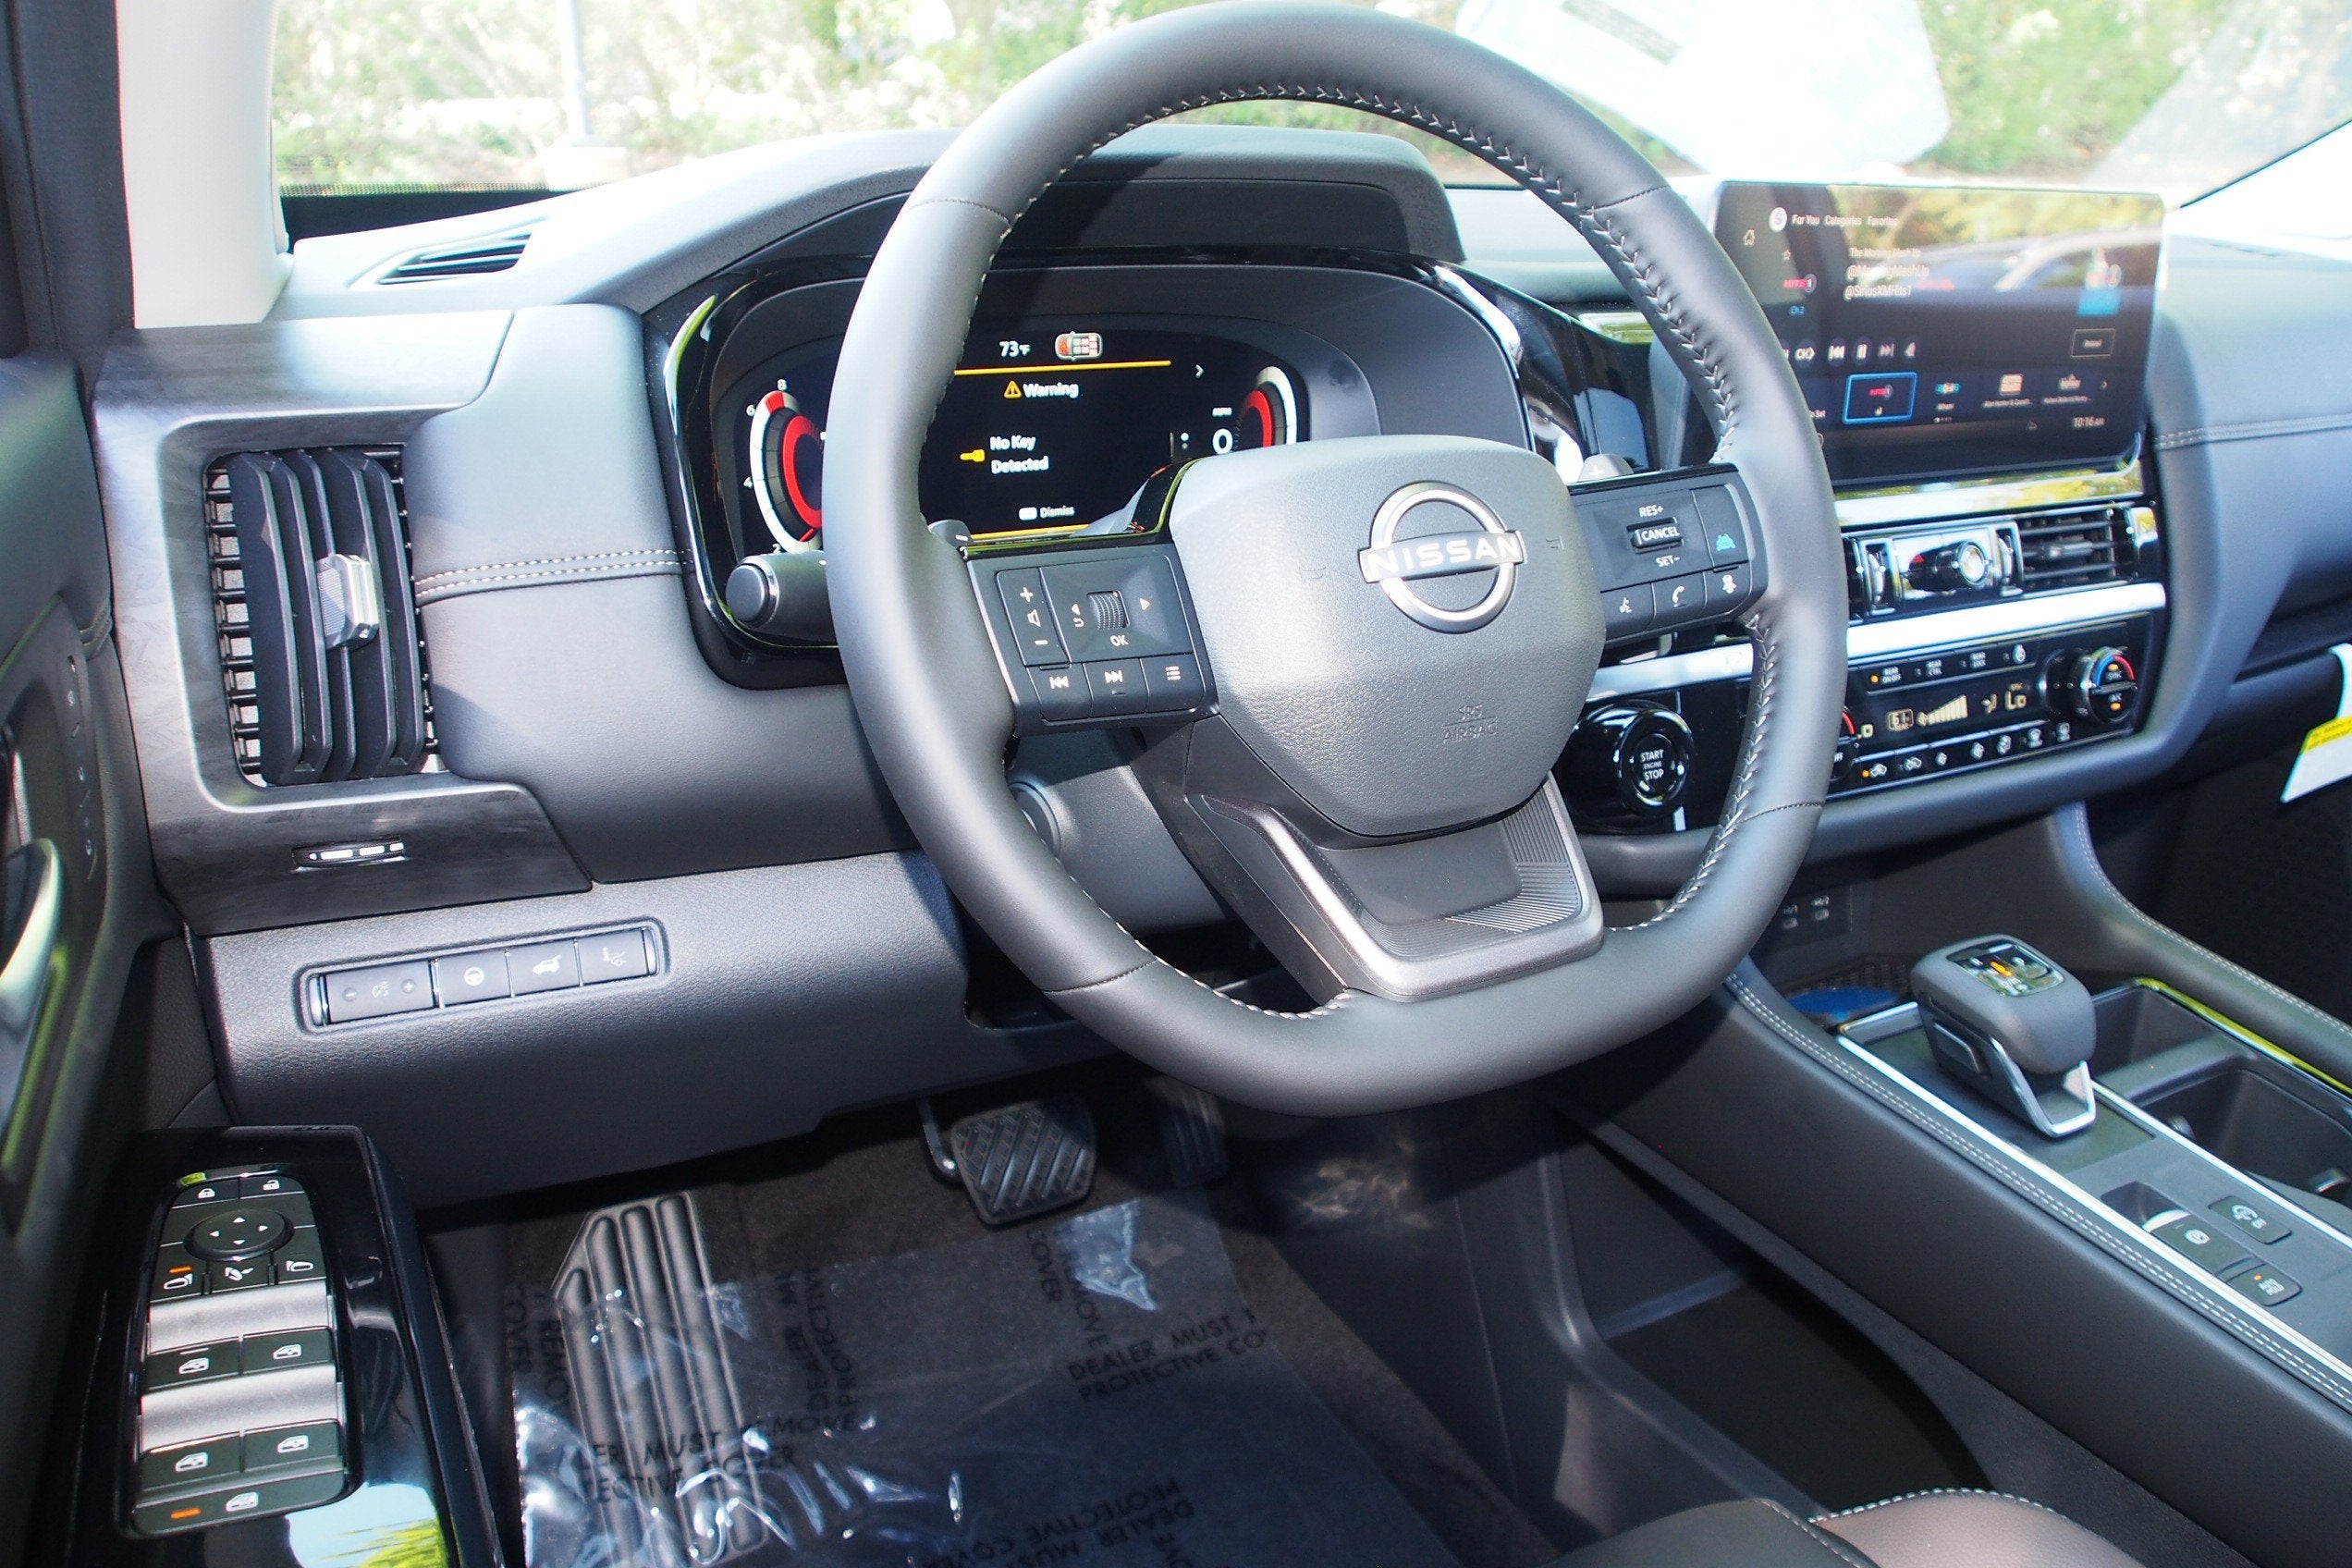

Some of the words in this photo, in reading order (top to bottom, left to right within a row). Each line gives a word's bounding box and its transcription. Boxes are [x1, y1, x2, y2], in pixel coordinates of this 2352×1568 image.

[1792, 214, 1805, 225] For
[1806, 214, 1819, 225] You
[1023, 382, 1080, 399] Warning
[746, 404, 755, 416] 6
[990, 436, 1011, 450] No
[1011, 435, 1035, 451] Key
[991, 456, 1049, 474] Detected
[1040, 505, 1075, 519] Dismiss
[1641, 526, 1681, 542] CANCEL
[1365, 536, 1522, 574] NISSAN
[1110, 634, 1129, 647] OK
[1641, 749, 1664, 762] START
[1644, 760, 1662, 770] ENGINE
[1645, 768, 1664, 781] STOP
[1068, 1339, 1158, 1380] DEALER
[1170, 1314, 1233, 1348] MUST
